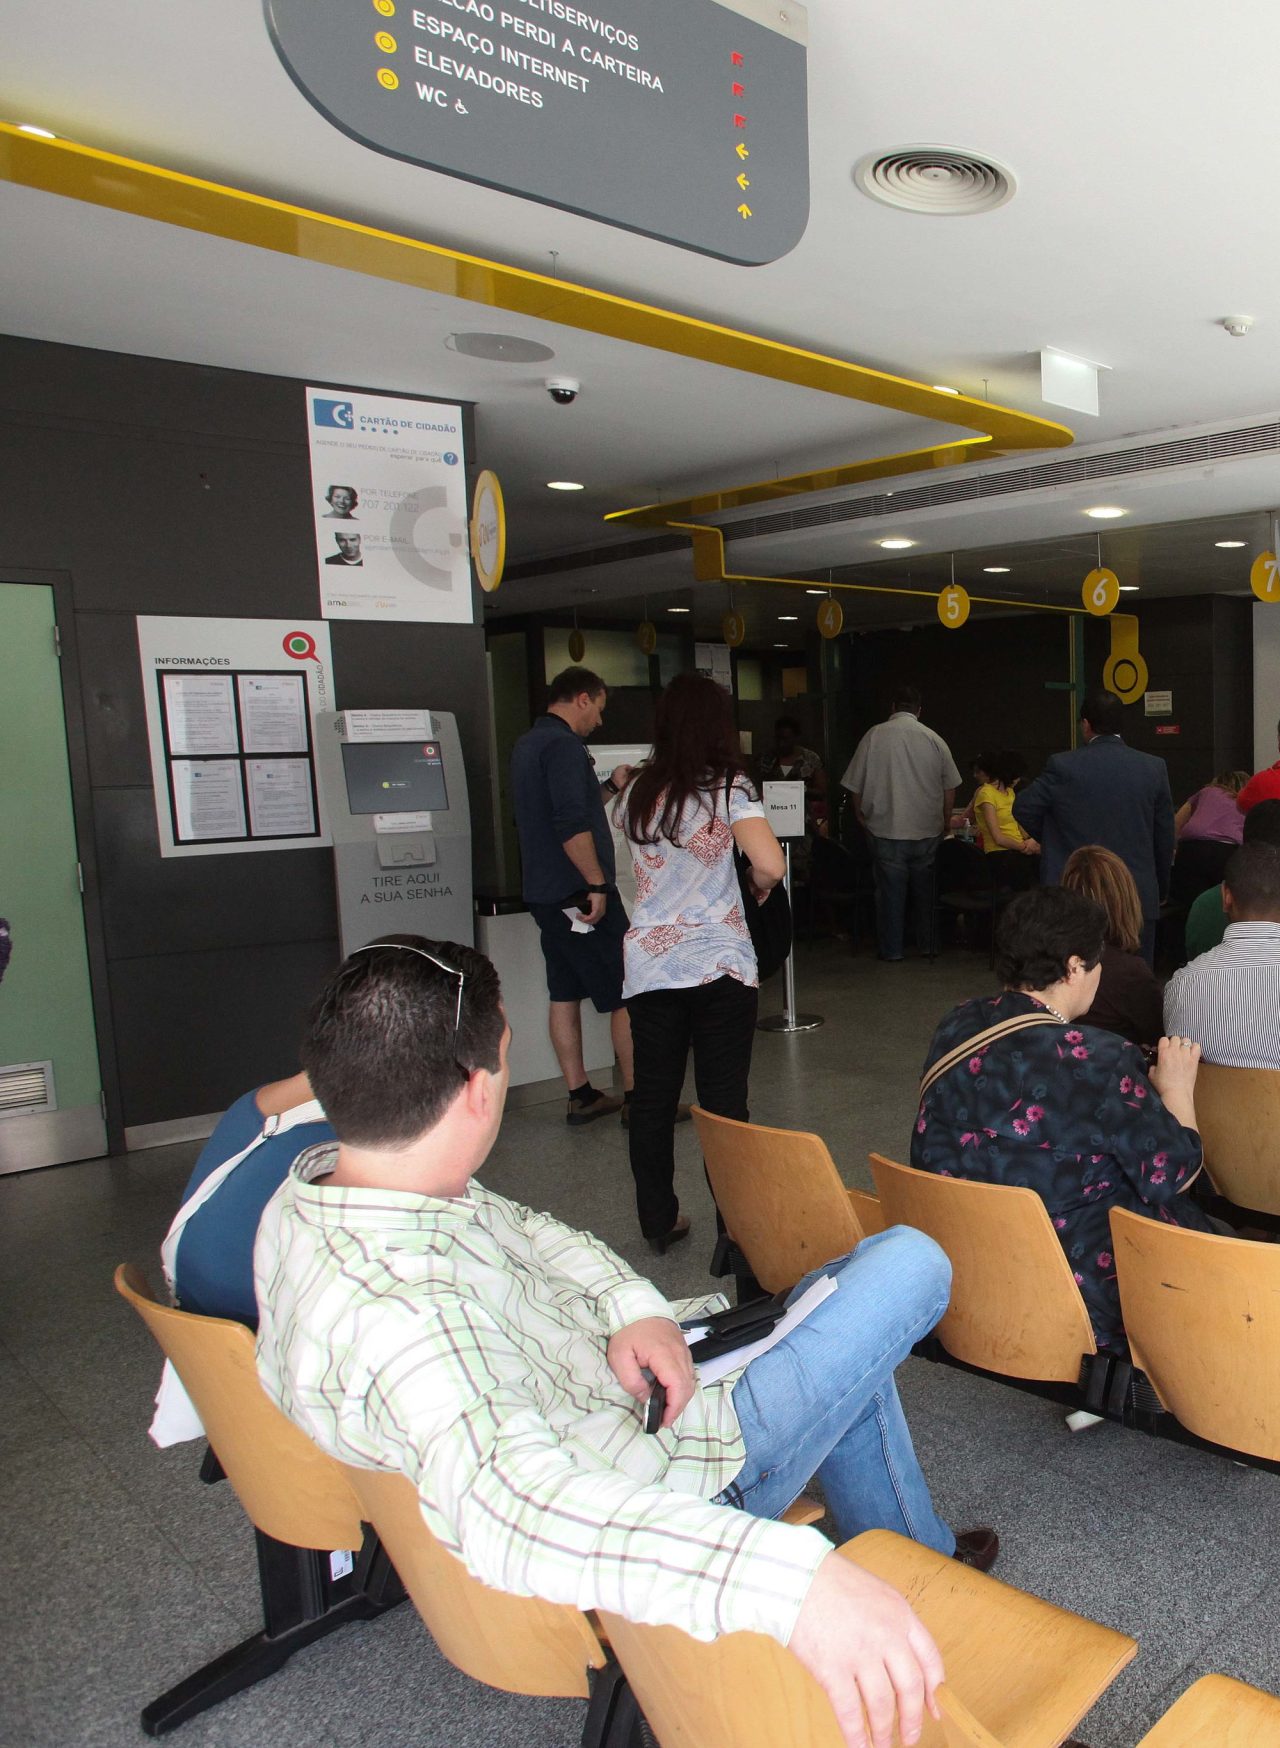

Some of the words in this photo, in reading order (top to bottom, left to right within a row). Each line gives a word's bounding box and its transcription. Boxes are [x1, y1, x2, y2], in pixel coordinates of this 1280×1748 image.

[413, 10, 494, 56] ESPAÇO
[501, 45, 589, 93] INTERNET
[501, 12, 556, 49] PERDI
[562, 39, 575, 56] A
[580, 46, 664, 93] CARTEIRA
[415, 46, 543, 108] ELEVADORES
[415, 82, 448, 107] WC
[360, 415, 399, 427] CARTÃO
[416, 422, 456, 433] CIDADÃO
[1265, 561, 1280, 592] 7
[1093, 578, 1108, 606] 6
[825, 607, 833, 630] 4
[947, 594, 960, 620] 5
[155, 657, 230, 666] INFORMAÇÕES
[318, 664, 326, 695] CIDADÃO
[372, 876, 402, 887] TIRE
[406, 873, 440, 884] AQUI
[361, 894, 370, 904] A
[374, 892, 402, 903] SUA
[407, 887, 453, 899] SENHA
